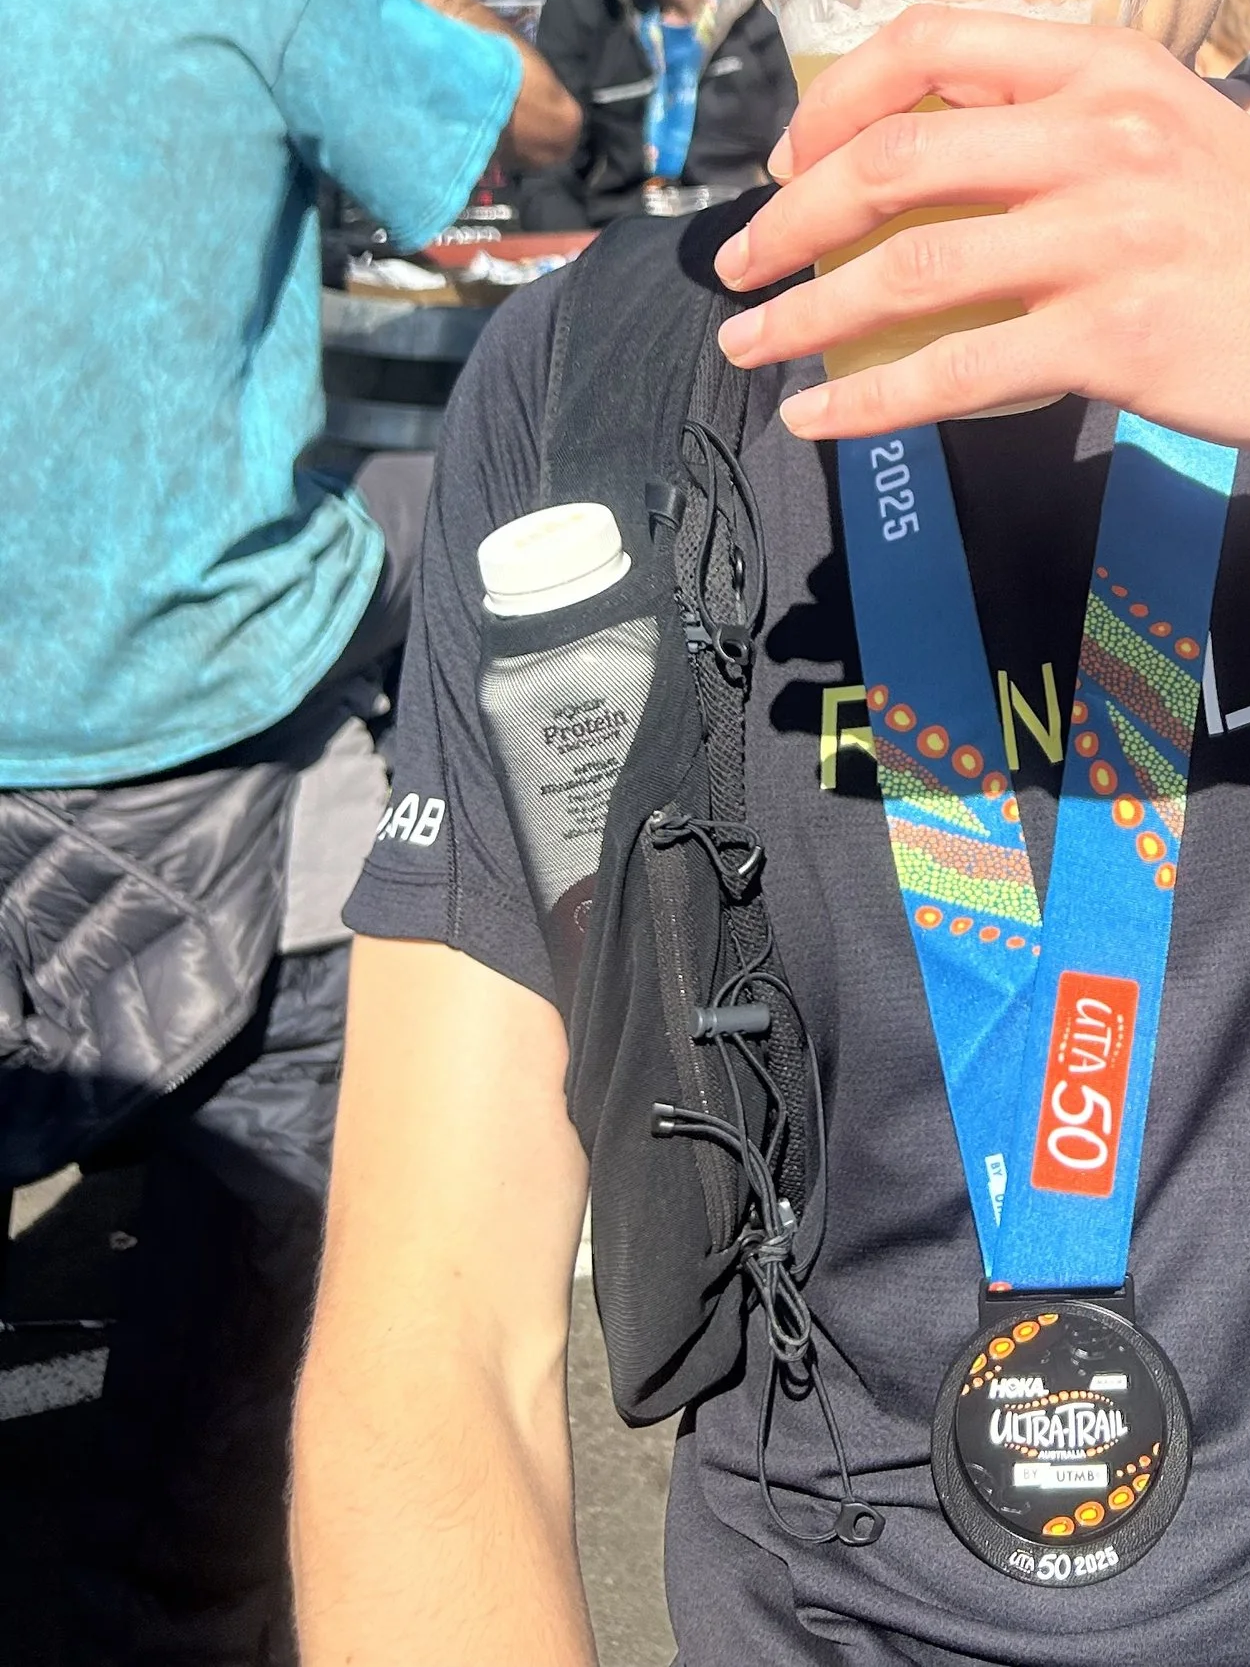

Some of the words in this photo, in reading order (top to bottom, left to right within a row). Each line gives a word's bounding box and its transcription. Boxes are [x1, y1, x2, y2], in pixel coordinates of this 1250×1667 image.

[870, 439, 920, 541] 2025
[543, 711, 628, 744] Protein
[1047, 1080, 1112, 1170] 50
[989, 1377, 1049, 1399] HOKA
[1037, 1449, 1087, 1460] AUSTRALIA
[1023, 1469, 1038, 1480] BY
[1036, 1553, 1072, 1581] 50
[1073, 1545, 1120, 1576] 2025
